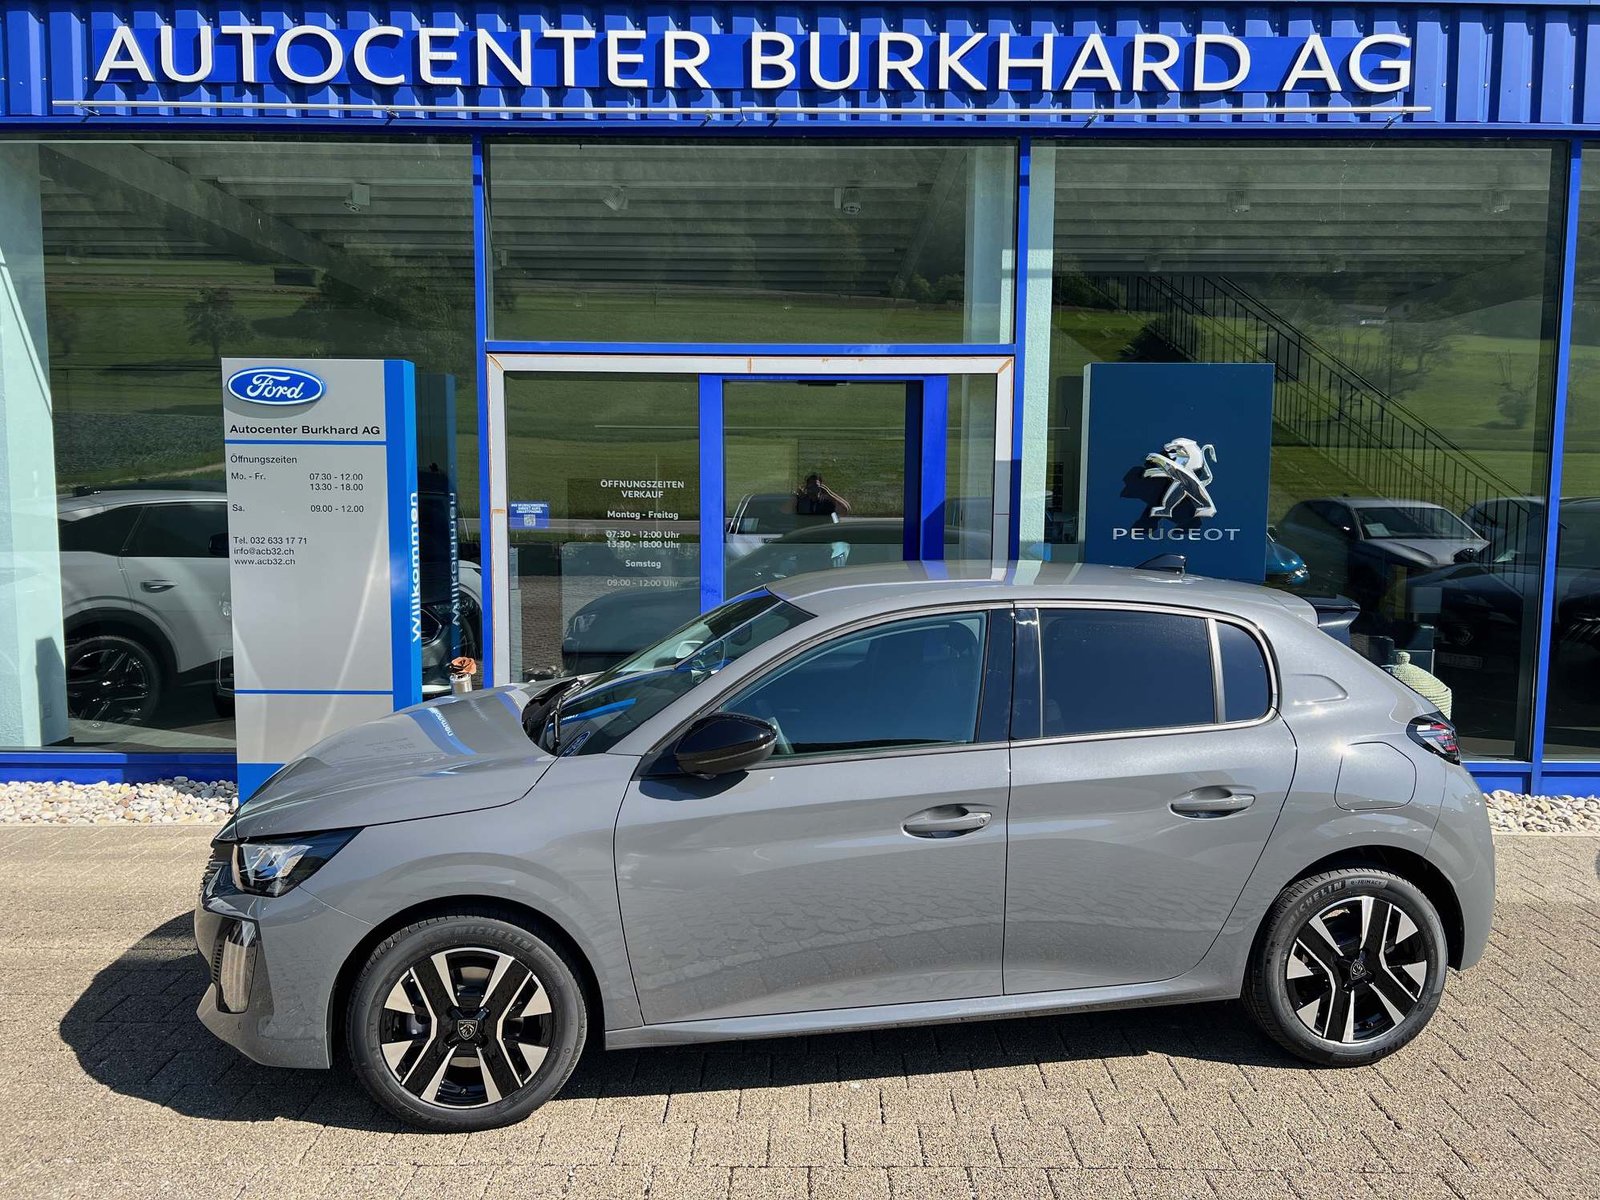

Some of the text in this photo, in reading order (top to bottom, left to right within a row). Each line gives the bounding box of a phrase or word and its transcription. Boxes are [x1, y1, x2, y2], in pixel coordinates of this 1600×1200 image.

[94, 25, 1413, 93] AUTOCENTER BURKHARD AG
[246, 373, 304, 399] Ford
[229, 425, 381, 435] Autocenter Burkhard AG
[230, 453, 298, 465] Öffnungszeiten
[231, 472, 247, 480] Mo.
[254, 472, 267, 480] Fr.
[309, 473, 332, 481] 07.30
[340, 473, 364, 481] 12.00
[309, 483, 332, 491] 13.30
[340, 483, 364, 491] 18.00
[600, 479, 685, 489] ÖFFNUNGSZEITEN
[621, 490, 664, 498] VERKAUF
[232, 504, 246, 512] Sa.
[310, 505, 333, 513] 09.00
[341, 505, 365, 513] 12.00
[607, 510, 641, 520] Montag
[648, 510, 679, 520] Freitag
[1112, 527, 1241, 541] PEUGEOT
[233, 536, 307, 545] Tel. 032 633 17 71
[233, 547, 295, 556] info@acb32.ch
[410, 492, 421, 643] Willkommen
[625, 559, 661, 569] Samstag
[607, 579, 631, 587] 09:00
[639, 579, 661, 587] 12:00
[663, 579, 679, 587] Uhr
[1286, 881, 1343, 927] MICHELIN
